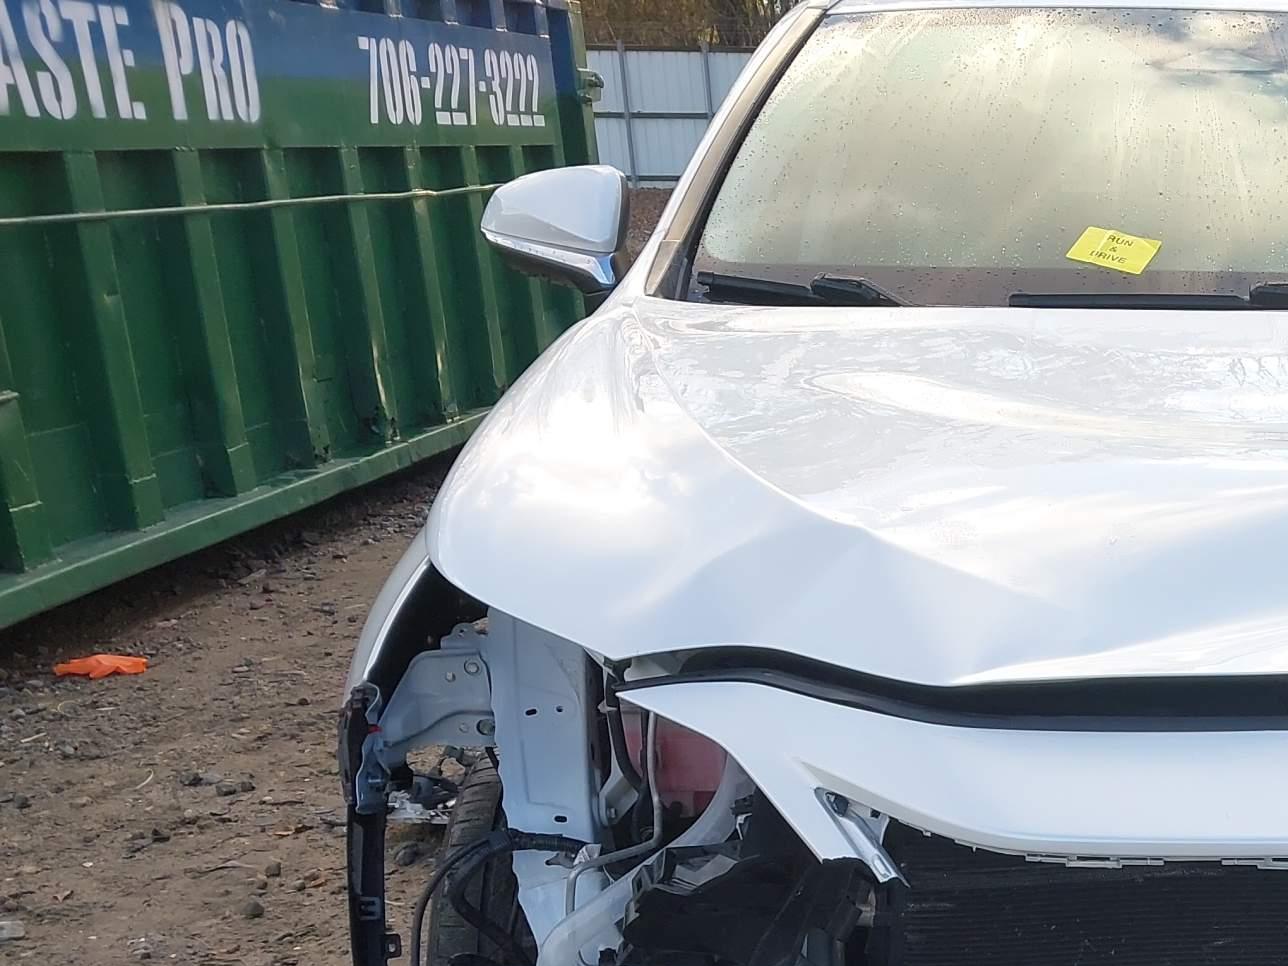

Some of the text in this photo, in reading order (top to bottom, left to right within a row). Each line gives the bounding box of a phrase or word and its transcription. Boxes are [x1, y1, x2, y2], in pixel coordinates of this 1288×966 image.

[152, 0, 261, 123] PRO
[357, 36, 546, 127] 706-227-3222
[1107, 234, 1134, 247] RUN
